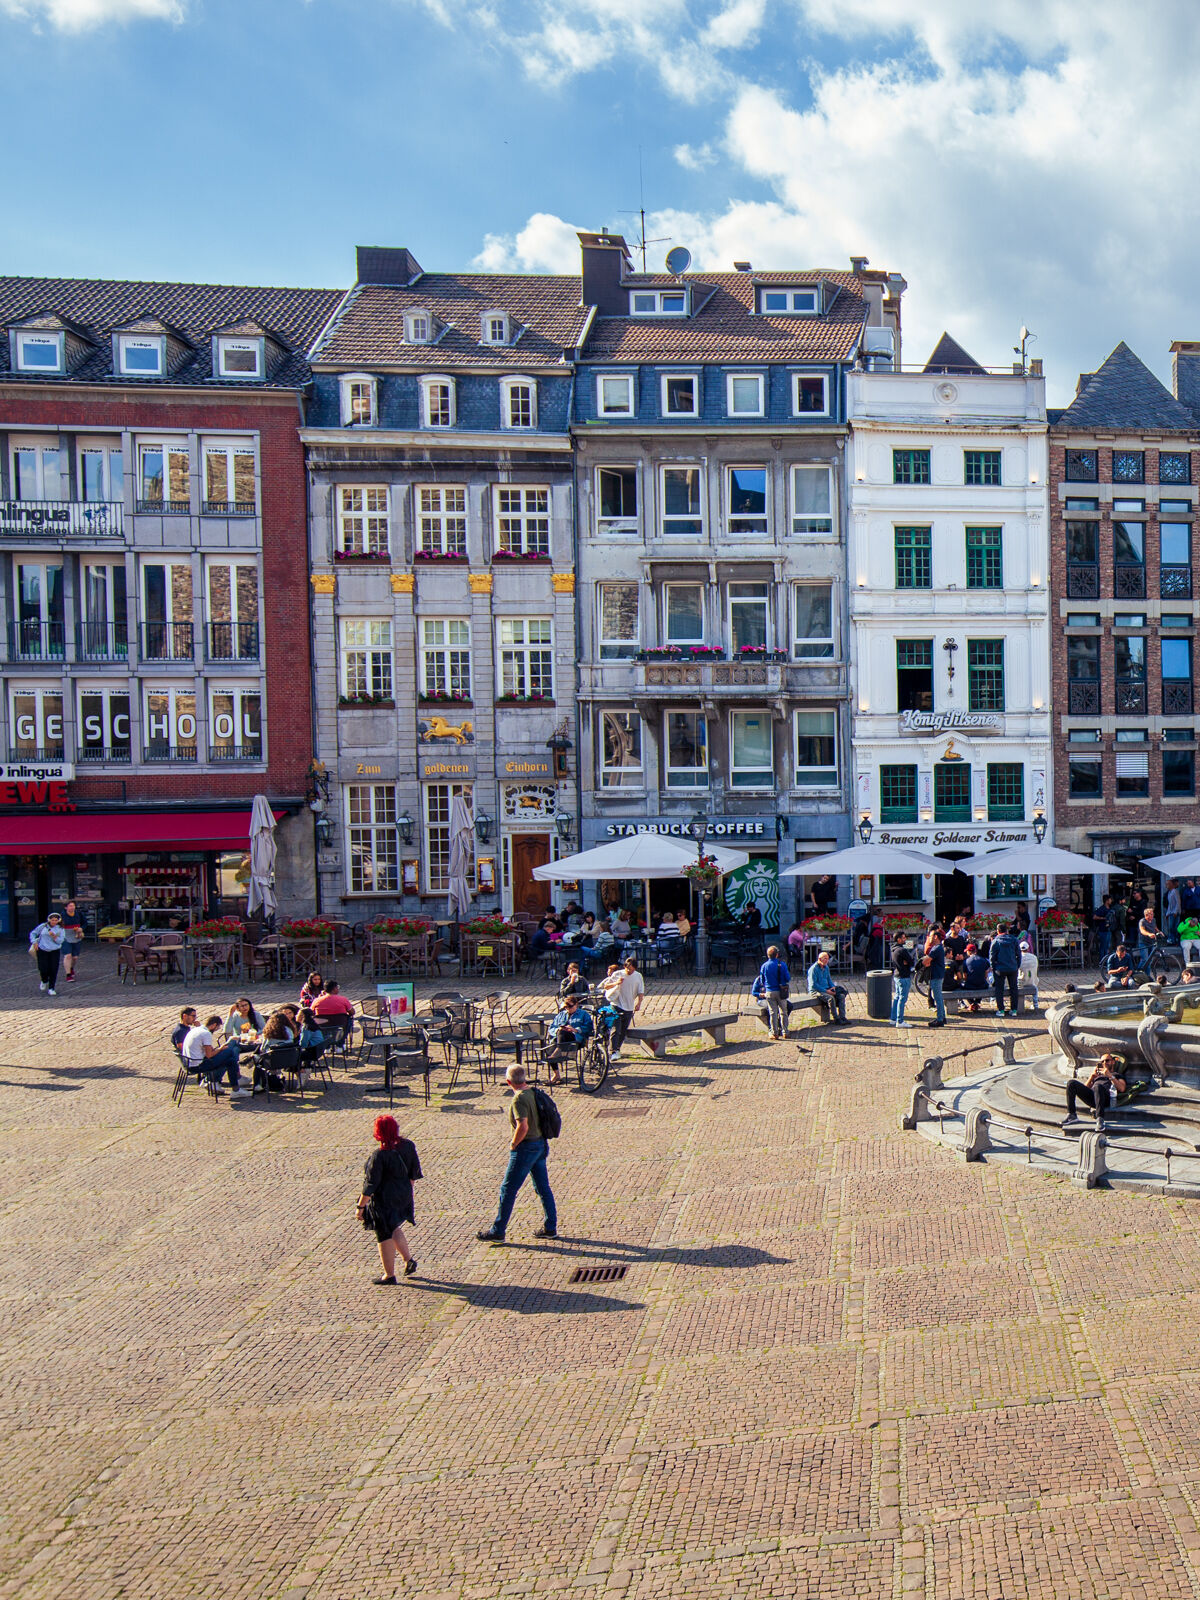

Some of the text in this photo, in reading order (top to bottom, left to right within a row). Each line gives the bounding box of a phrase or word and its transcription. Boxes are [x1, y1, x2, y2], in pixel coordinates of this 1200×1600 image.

[901, 709, 943, 730] König
[7, 765, 63, 780] inlingua
[356, 761, 548, 775] Zum goldenen Einhorn
[0, 781, 69, 804] EWE
[47, 803, 78, 812] CITY
[706, 823, 764, 835] COFFEE
[932, 831, 981, 846] Goldener
[984, 830, 1027, 842] Schwan
